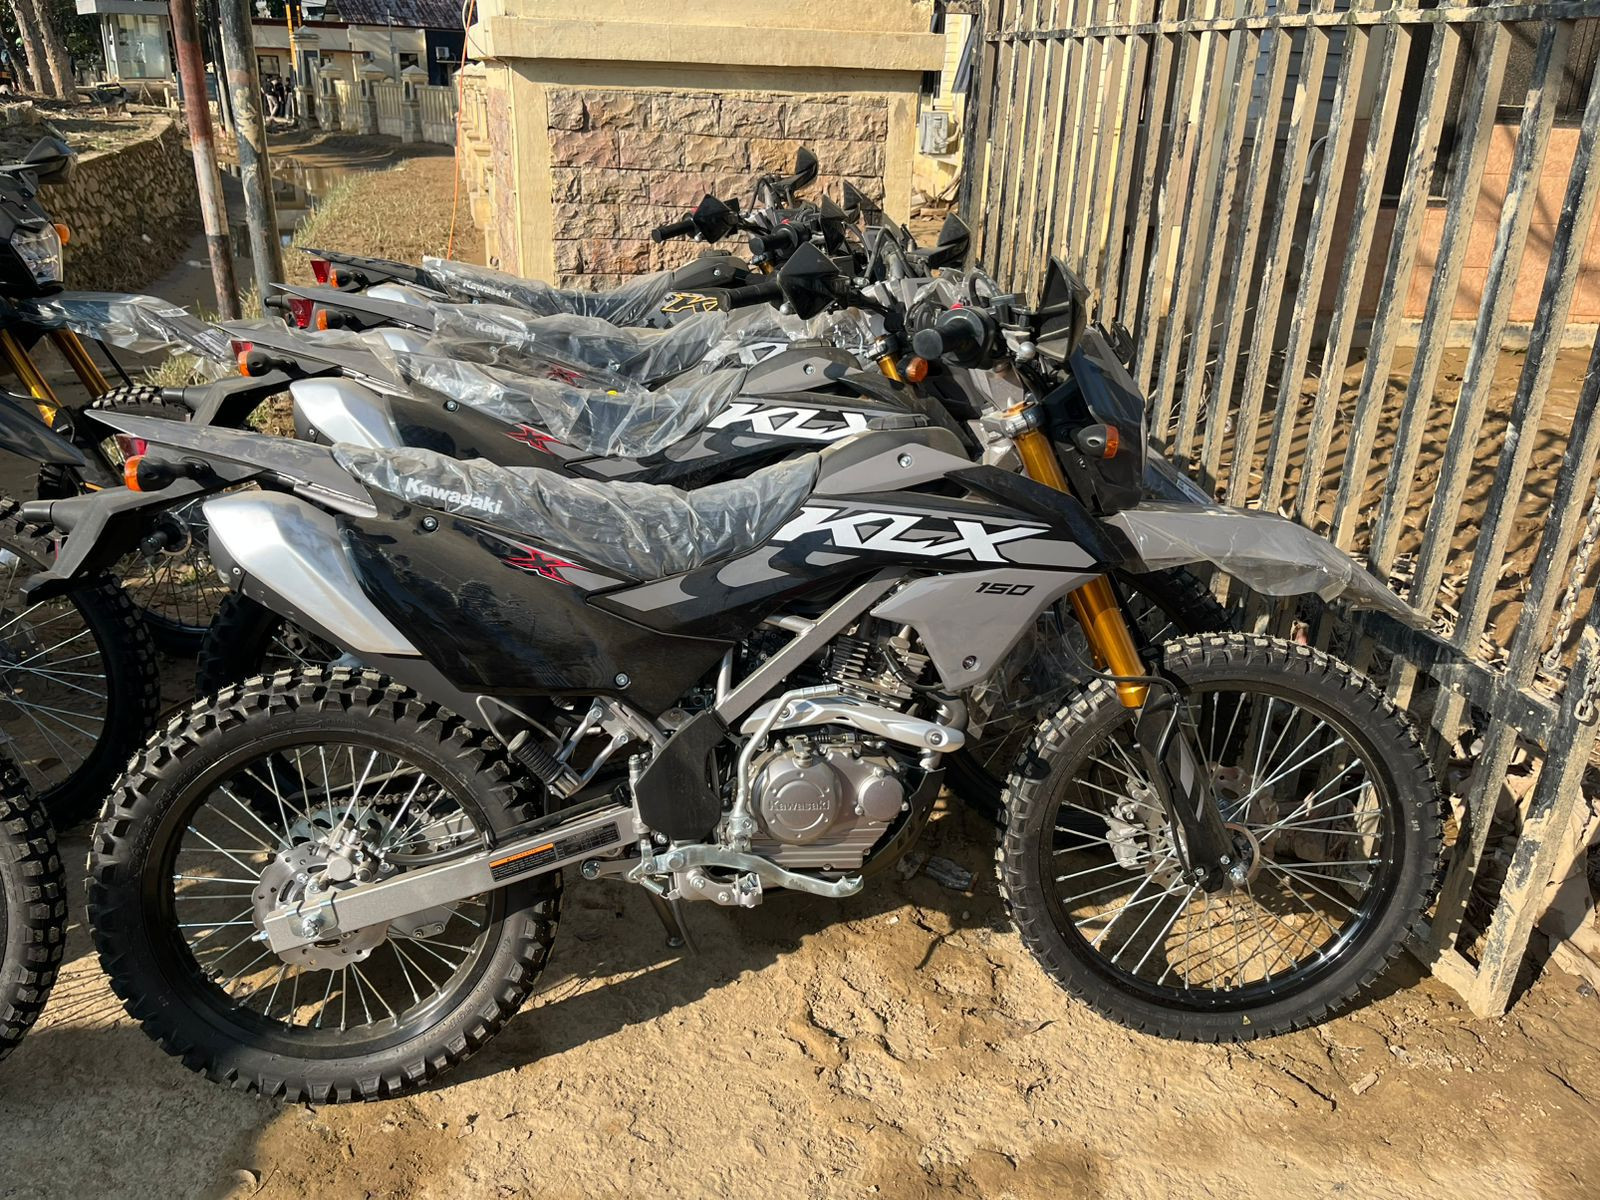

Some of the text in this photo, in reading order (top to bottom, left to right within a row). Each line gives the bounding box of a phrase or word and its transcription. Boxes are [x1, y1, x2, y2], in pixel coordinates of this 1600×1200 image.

[405, 477, 503, 514] Kawasaki
[772, 506, 1052, 563] KLX
[976, 582, 1036, 596] 150
[769, 800, 830, 812] Kawasaki
